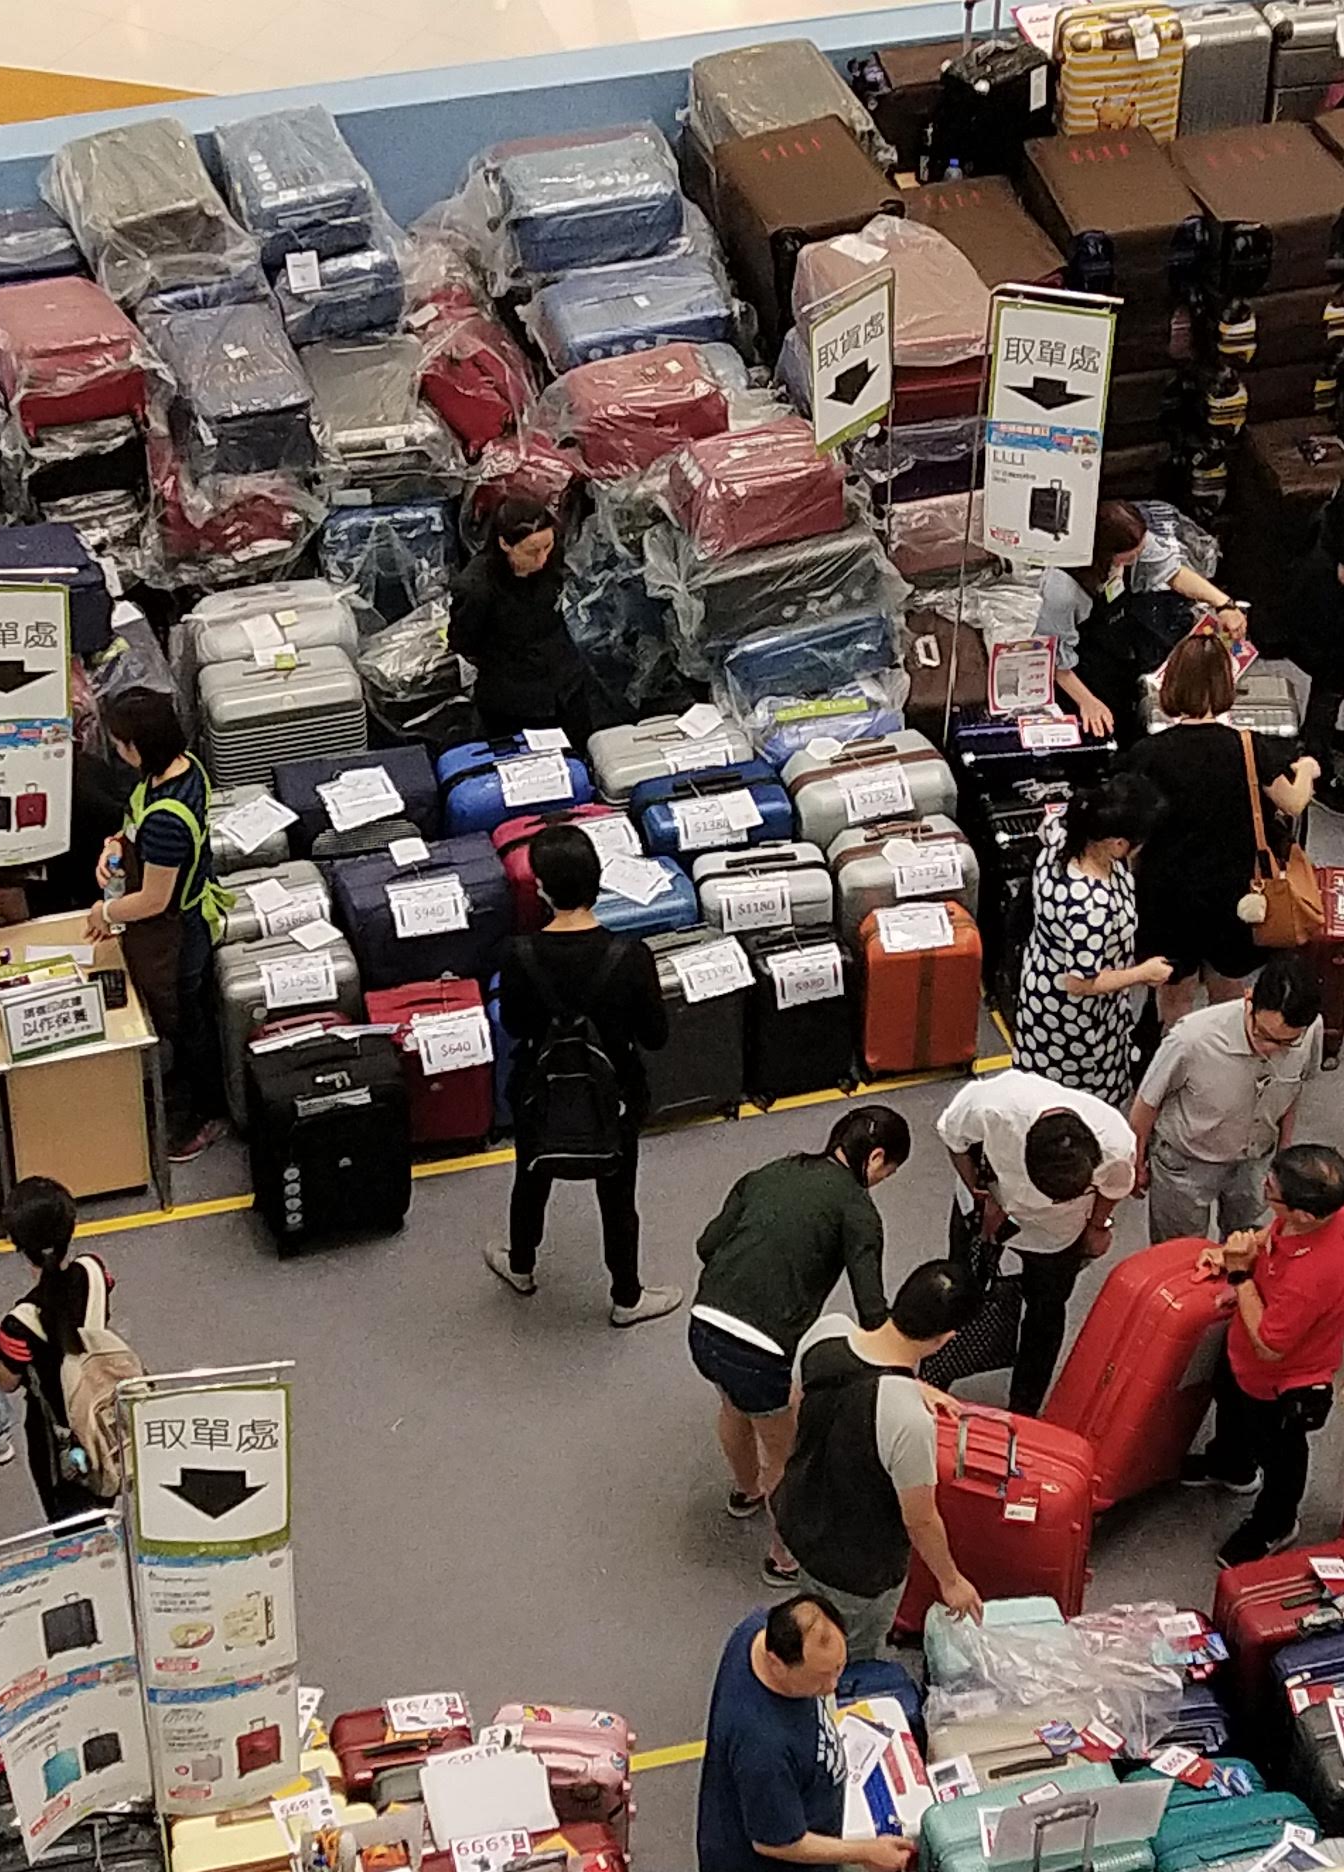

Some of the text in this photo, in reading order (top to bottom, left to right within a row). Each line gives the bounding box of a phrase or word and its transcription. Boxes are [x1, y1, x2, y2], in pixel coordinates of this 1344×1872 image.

[816, 311, 885, 373] 取貨處
[1003, 336, 1101, 375] 取單處
[144, 1418, 280, 1454] 取單處
